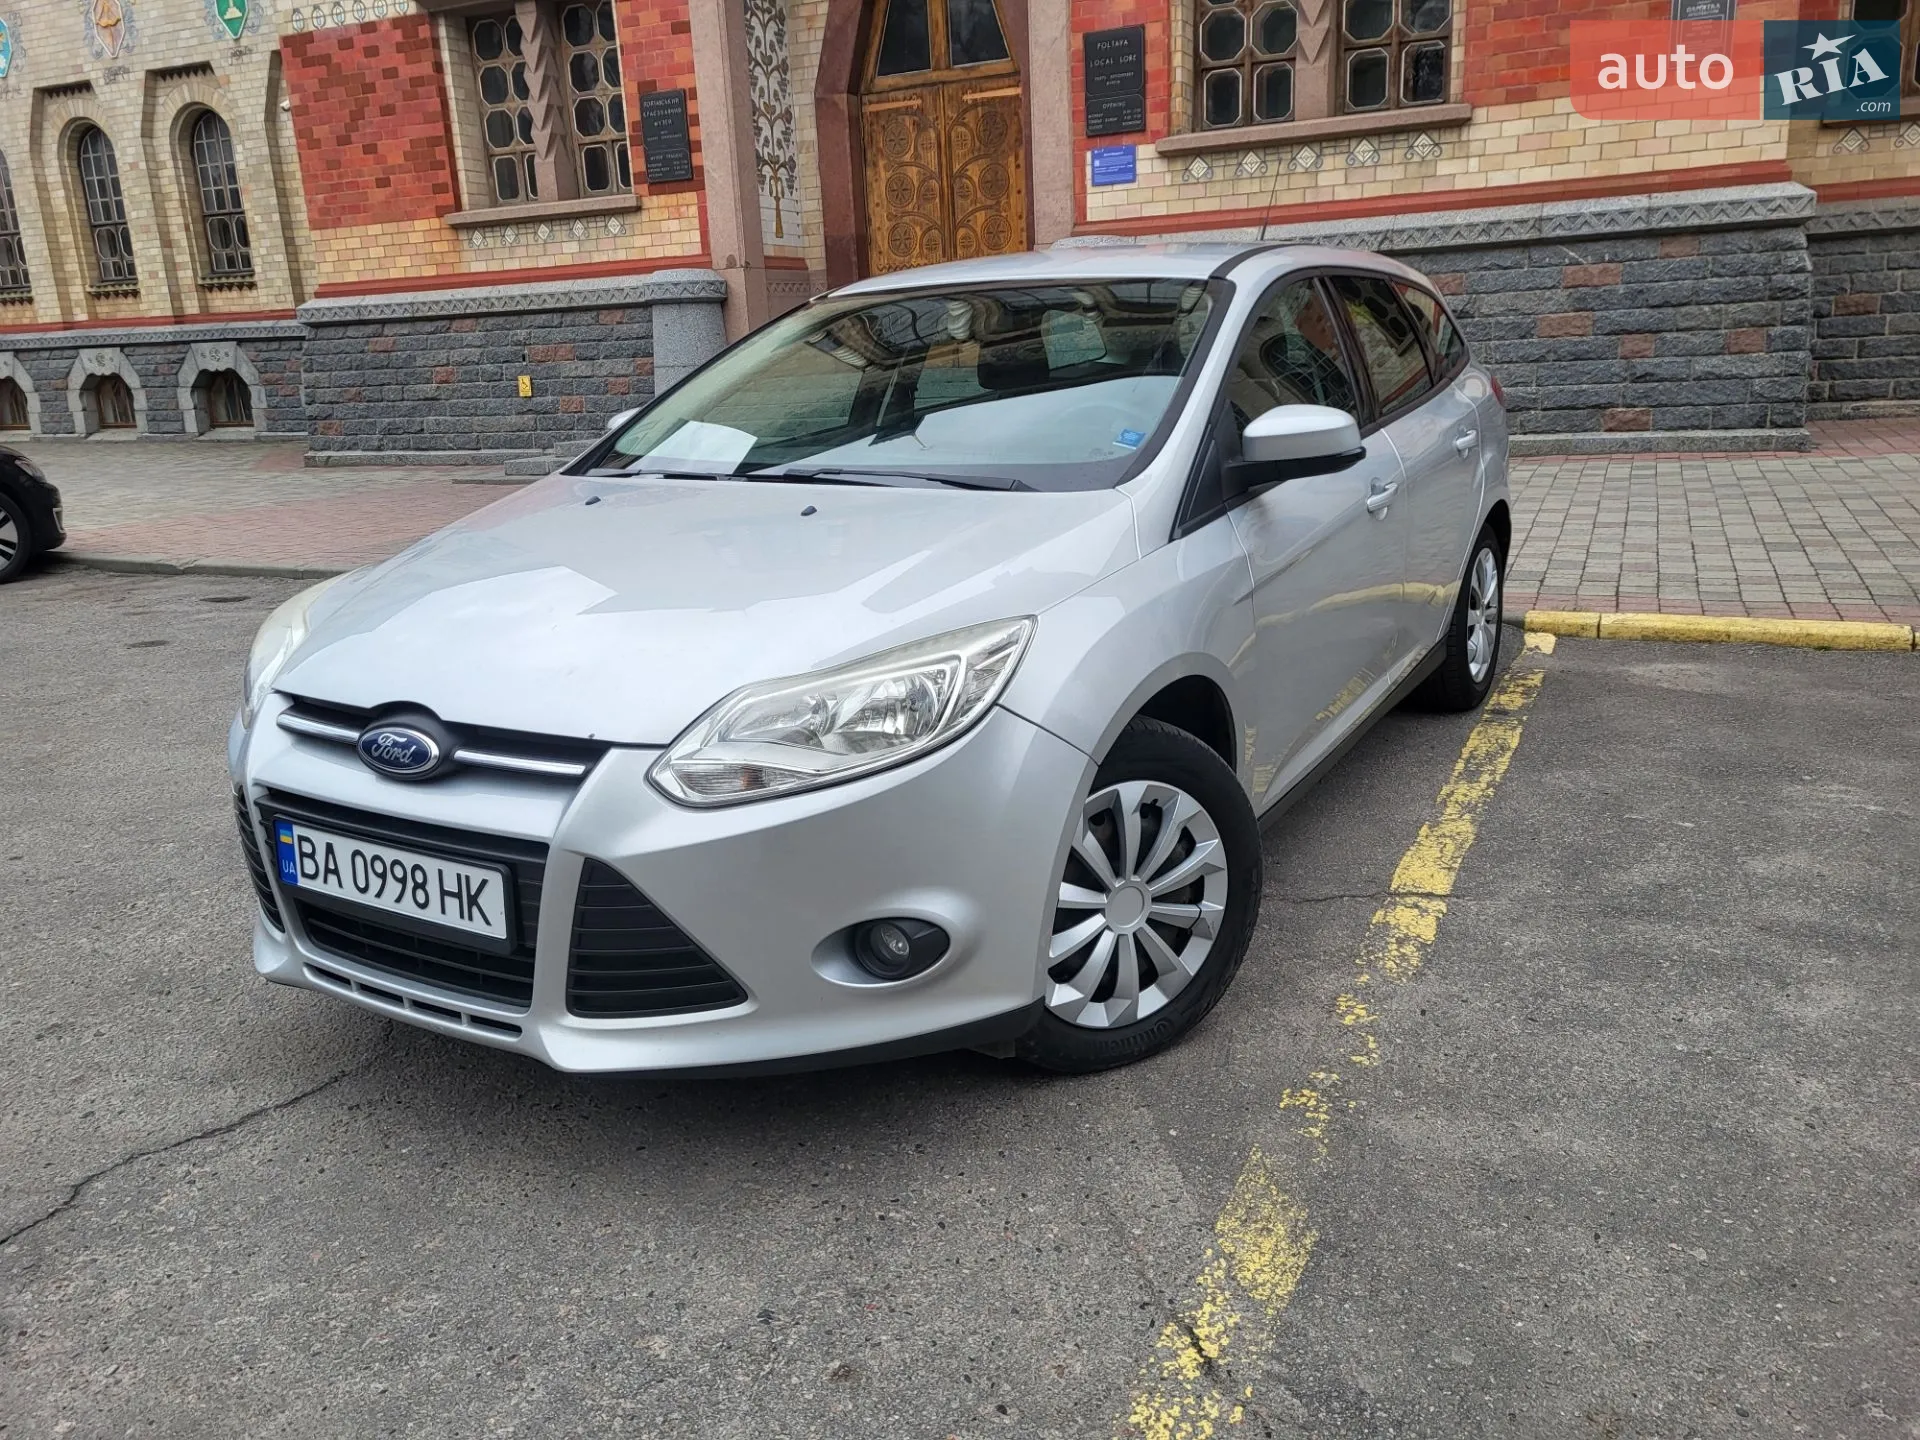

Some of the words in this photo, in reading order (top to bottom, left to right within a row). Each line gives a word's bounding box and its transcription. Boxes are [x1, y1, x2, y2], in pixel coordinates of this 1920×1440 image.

[1097, 39, 1129, 50] POLTAVA
[1090, 57, 1114, 68] LOCAL
[1119, 54, 1137, 65] LORE
[371, 733, 417, 763] Ford
[282, 859, 296, 875] UA
[297, 833, 344, 889] BA
[350, 849, 430, 910] 0998
[437, 868, 492, 927] HK
